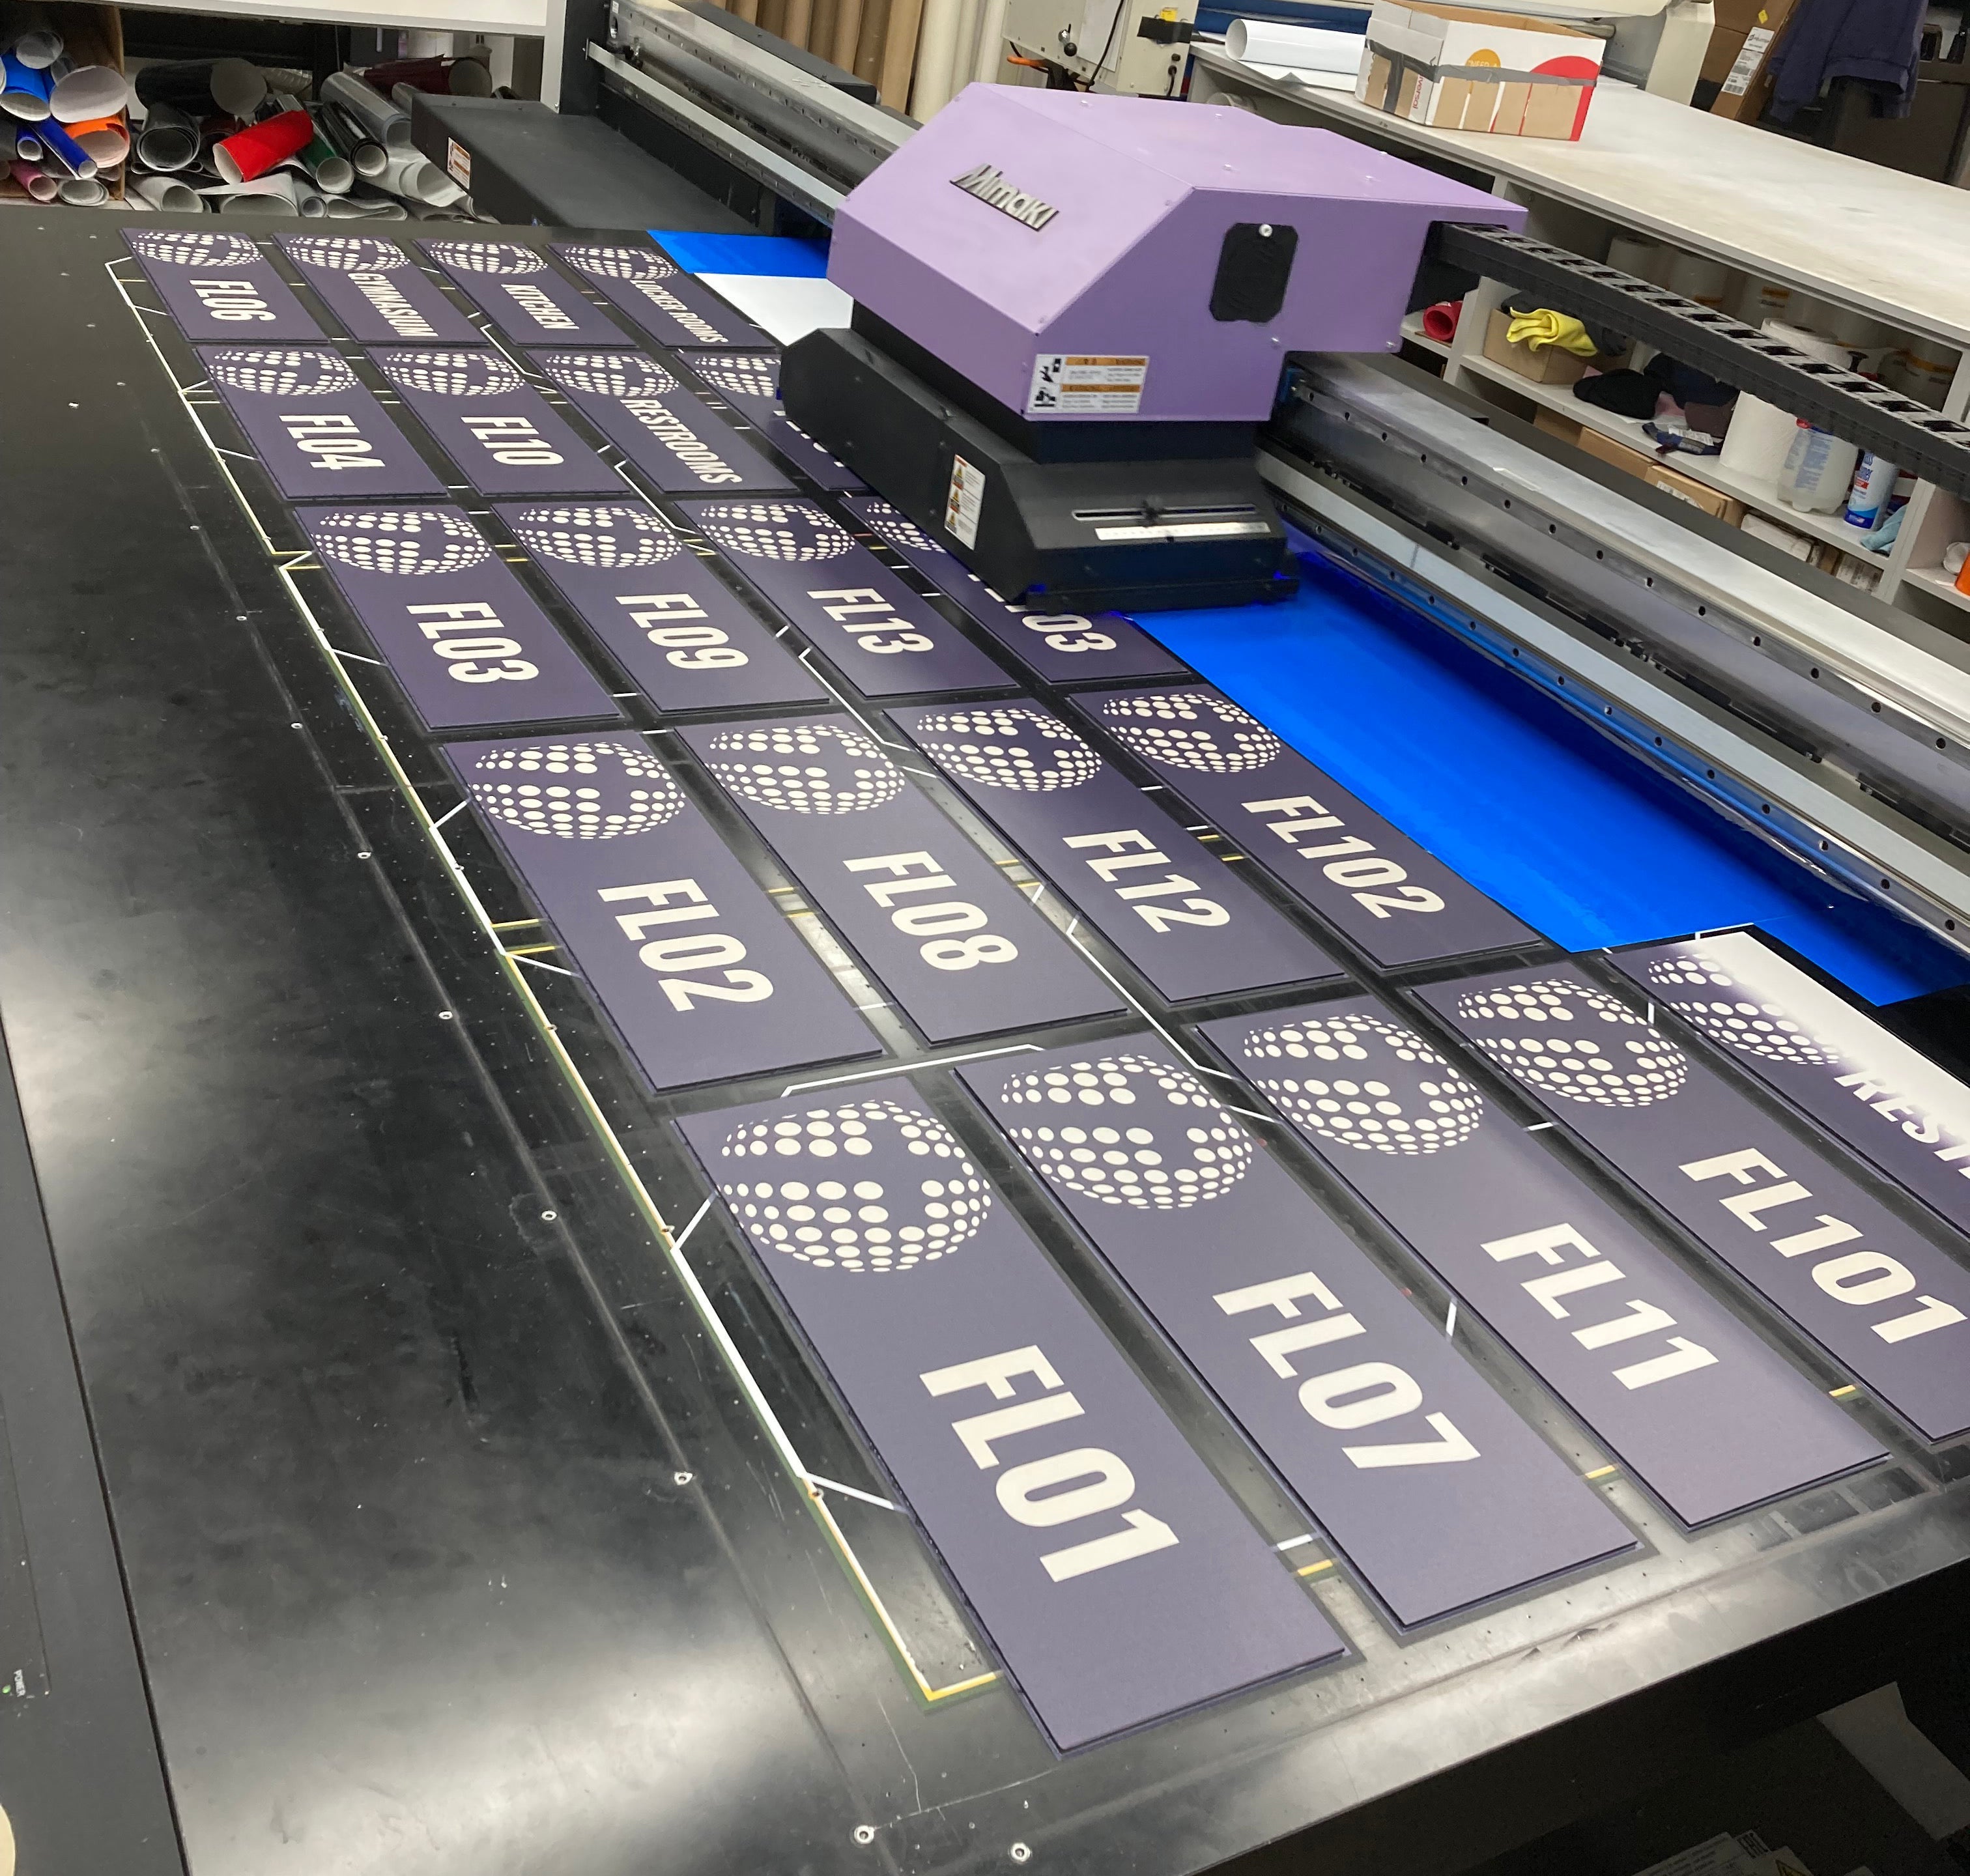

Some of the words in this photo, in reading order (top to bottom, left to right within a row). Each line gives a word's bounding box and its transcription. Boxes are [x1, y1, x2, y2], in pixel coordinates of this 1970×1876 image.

[950, 163, 1059, 231] Mimaki
[188, 279, 276, 322] FL06
[347, 272, 439, 337] GYMNASIUM
[501, 284, 579, 330] KITCHEN
[629, 279, 688, 311] LOCKER
[668, 311, 729, 343] ROOMS
[279, 415, 386, 470] FL04
[461, 416, 564, 465] FL10
[620, 399, 743, 484] RESTROOMS
[406, 602, 539, 683] FL03
[615, 593, 749, 670] FL09
[807, 588, 934, 655] FL13
[1061, 829, 1231, 933] FL12
[1241, 795, 1445, 918] FL102
[597, 878, 775, 1012] FL02
[843, 851, 1019, 971] FL08
[1678, 1146, 1969, 1344] FL101
[1479, 1222, 1720, 1391] FL11
[1212, 1271, 1481, 1469] FL07
[919, 1344, 1180, 1583] FL01
